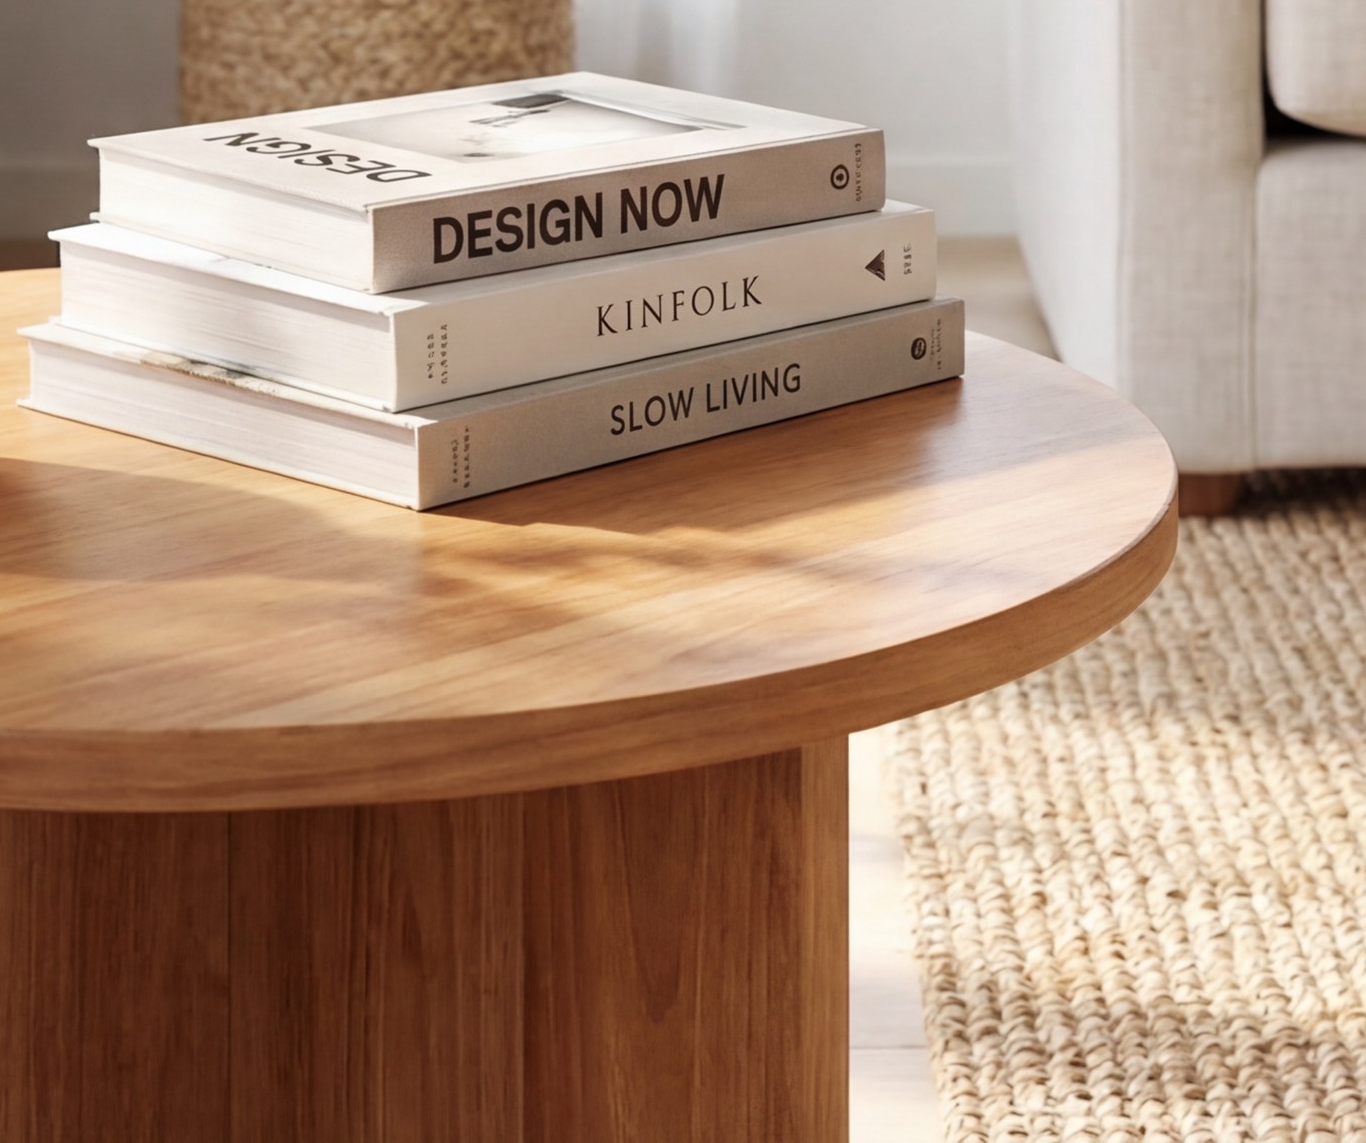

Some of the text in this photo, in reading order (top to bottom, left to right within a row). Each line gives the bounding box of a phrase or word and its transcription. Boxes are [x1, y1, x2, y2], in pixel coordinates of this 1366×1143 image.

[203, 132, 432, 182] DESIGN
[433, 174, 725, 264] DESIGN NOW
[597, 275, 762, 336] KINFOLK
[610, 363, 801, 436] SLOW LIVING
